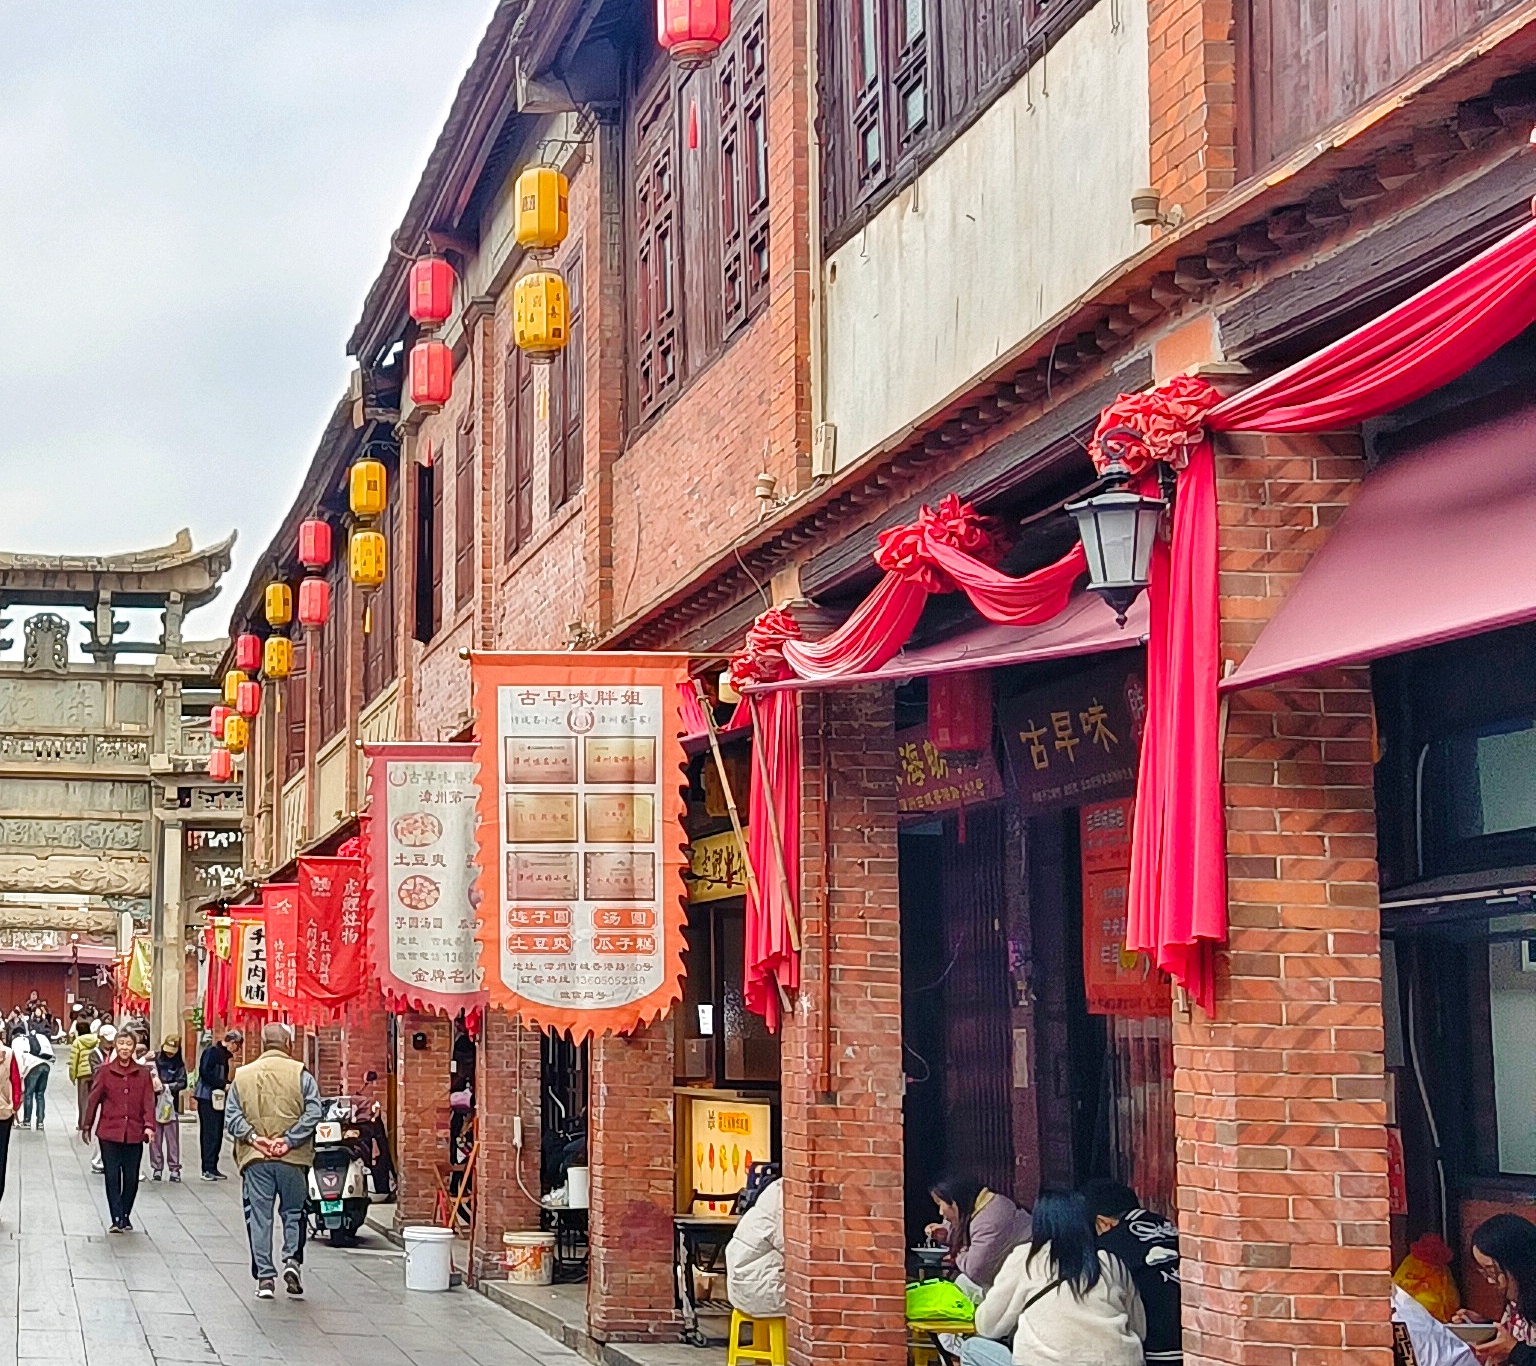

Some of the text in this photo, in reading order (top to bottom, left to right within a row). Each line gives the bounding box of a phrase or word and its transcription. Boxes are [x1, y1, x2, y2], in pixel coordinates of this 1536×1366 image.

[517, 690, 644, 706] 古早味胖姐
[1019, 696, 1119, 771] 古早味
[458, 917, 481, 930] 瓜子
